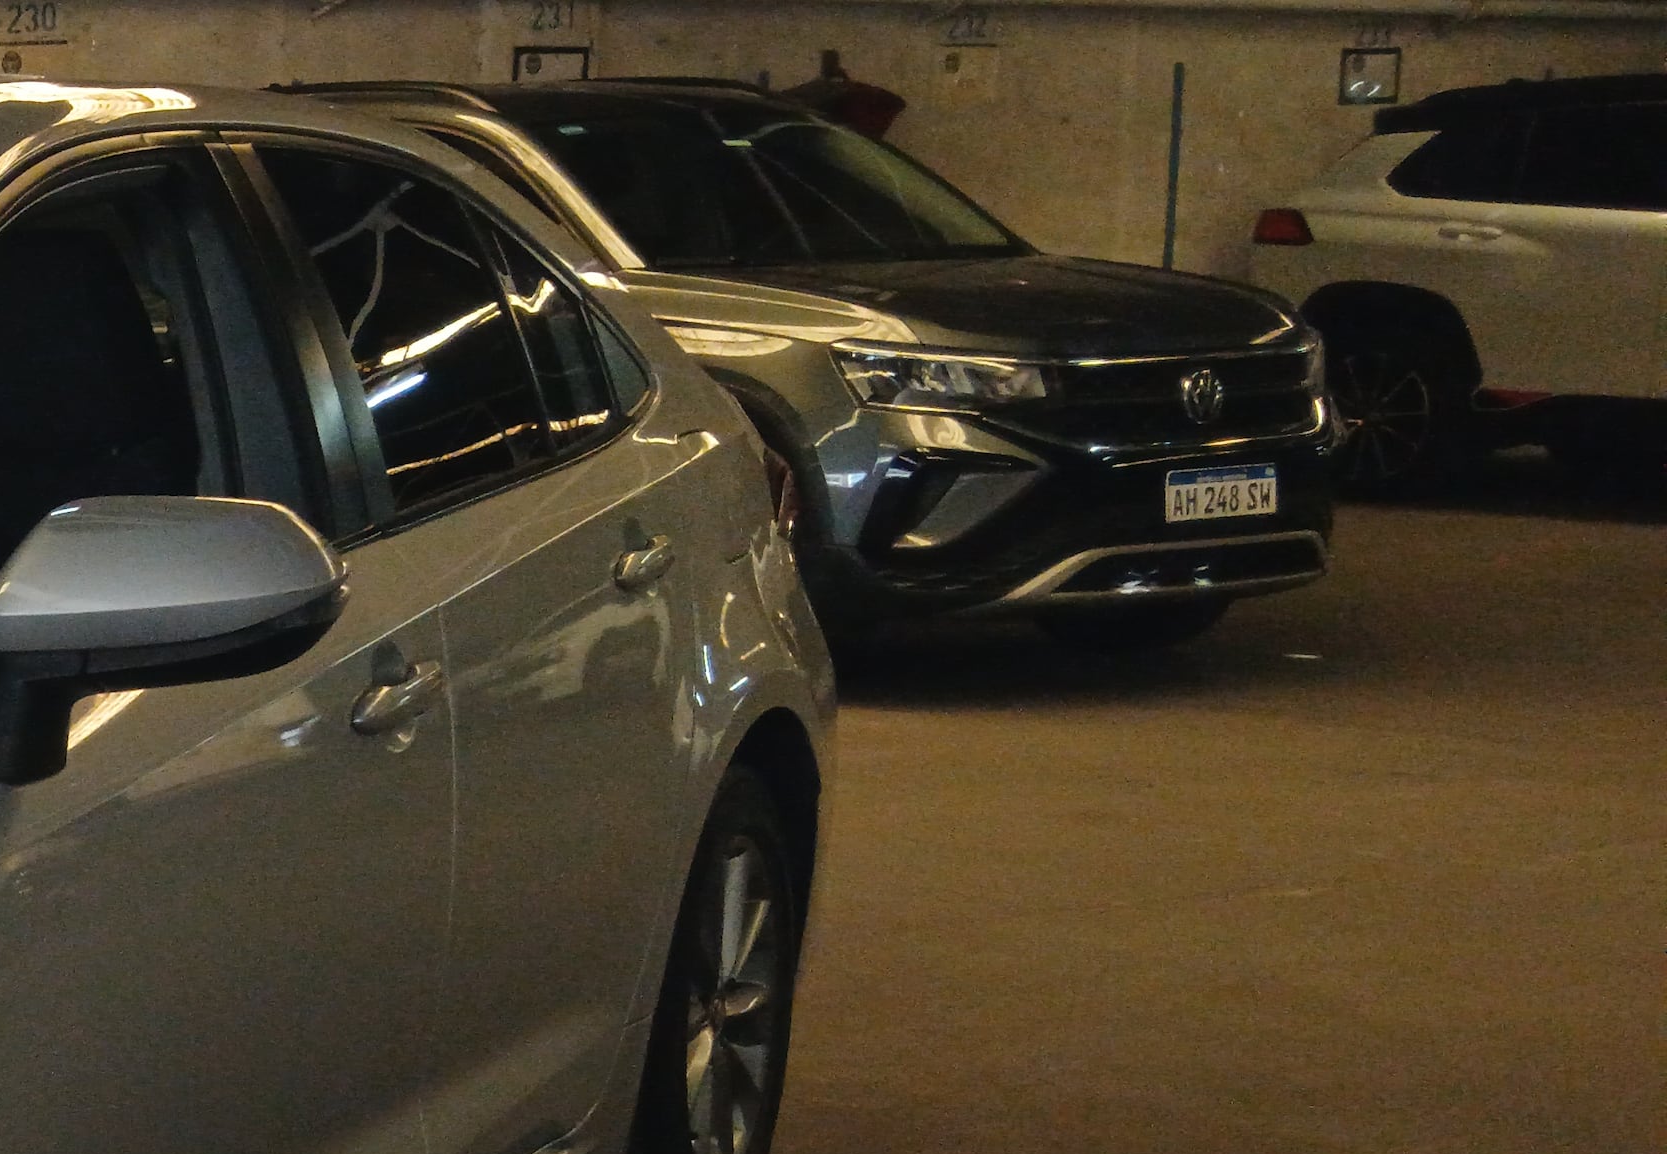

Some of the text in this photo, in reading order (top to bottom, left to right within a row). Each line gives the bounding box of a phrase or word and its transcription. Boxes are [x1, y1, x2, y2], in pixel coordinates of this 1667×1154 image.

[7, 2, 57, 34] 230
[532, 0, 573, 31] 231
[1173, 482, 1272, 517] AH 248 SW
